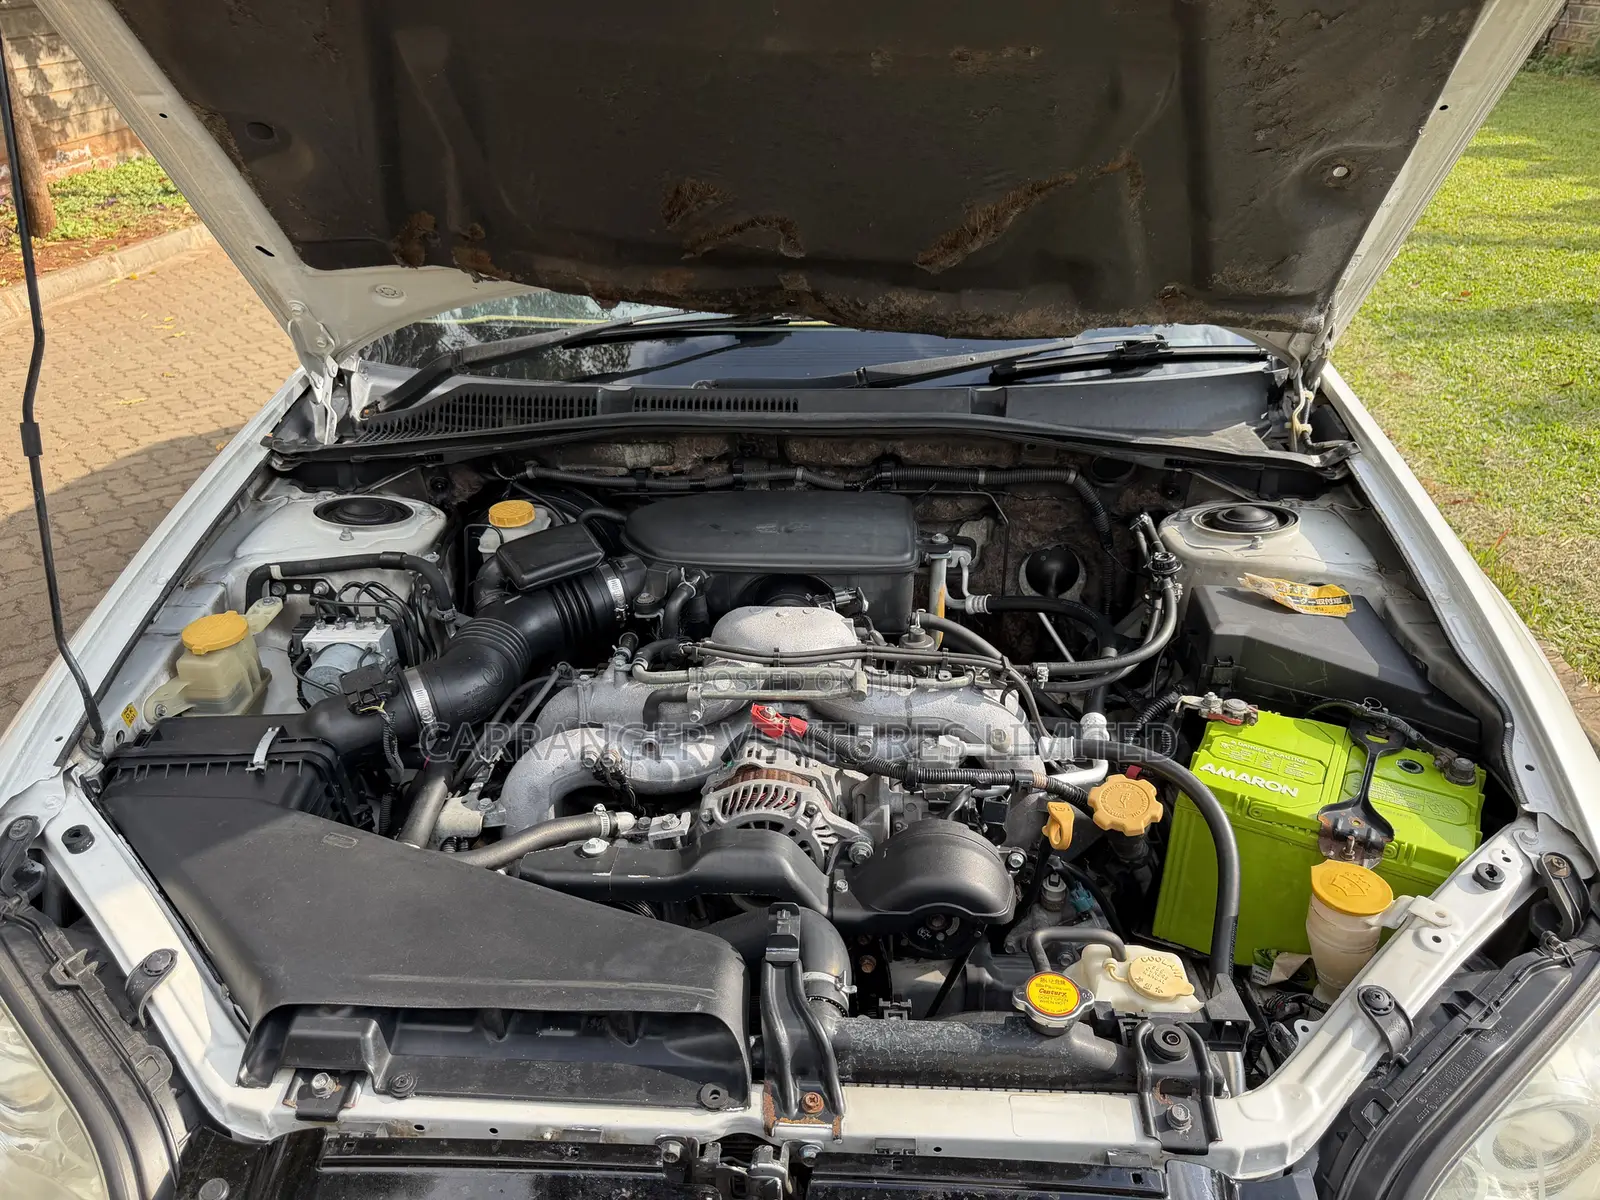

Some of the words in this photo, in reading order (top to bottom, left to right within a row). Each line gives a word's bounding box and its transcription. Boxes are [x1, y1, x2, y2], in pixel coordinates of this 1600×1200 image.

[1200, 762, 1299, 798] AMARON
[1140, 956, 1184, 980] COOLANT
[1038, 988, 1067, 997] Century
